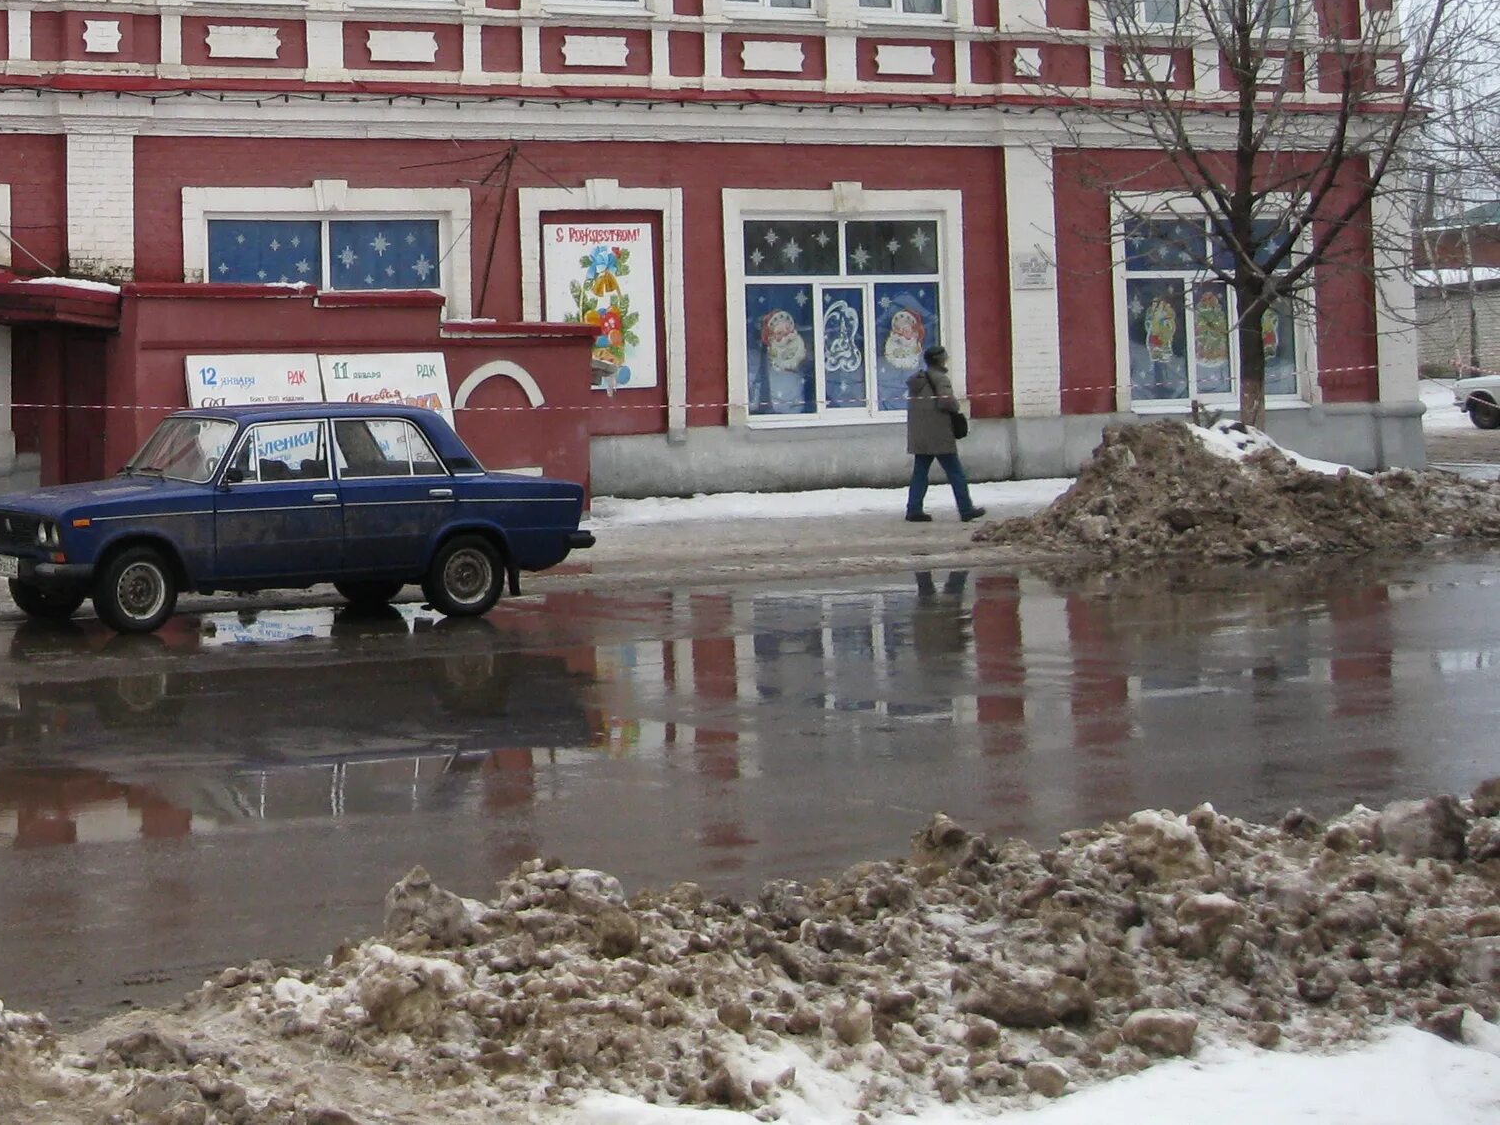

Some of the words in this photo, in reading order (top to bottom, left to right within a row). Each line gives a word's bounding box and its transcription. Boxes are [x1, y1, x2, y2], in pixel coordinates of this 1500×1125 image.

[556, 227, 564, 242] С
[199, 367, 218, 386] 12
[287, 370, 307, 386] РДК
[332, 361, 349, 380] 11
[416, 363, 437, 378] РДК
